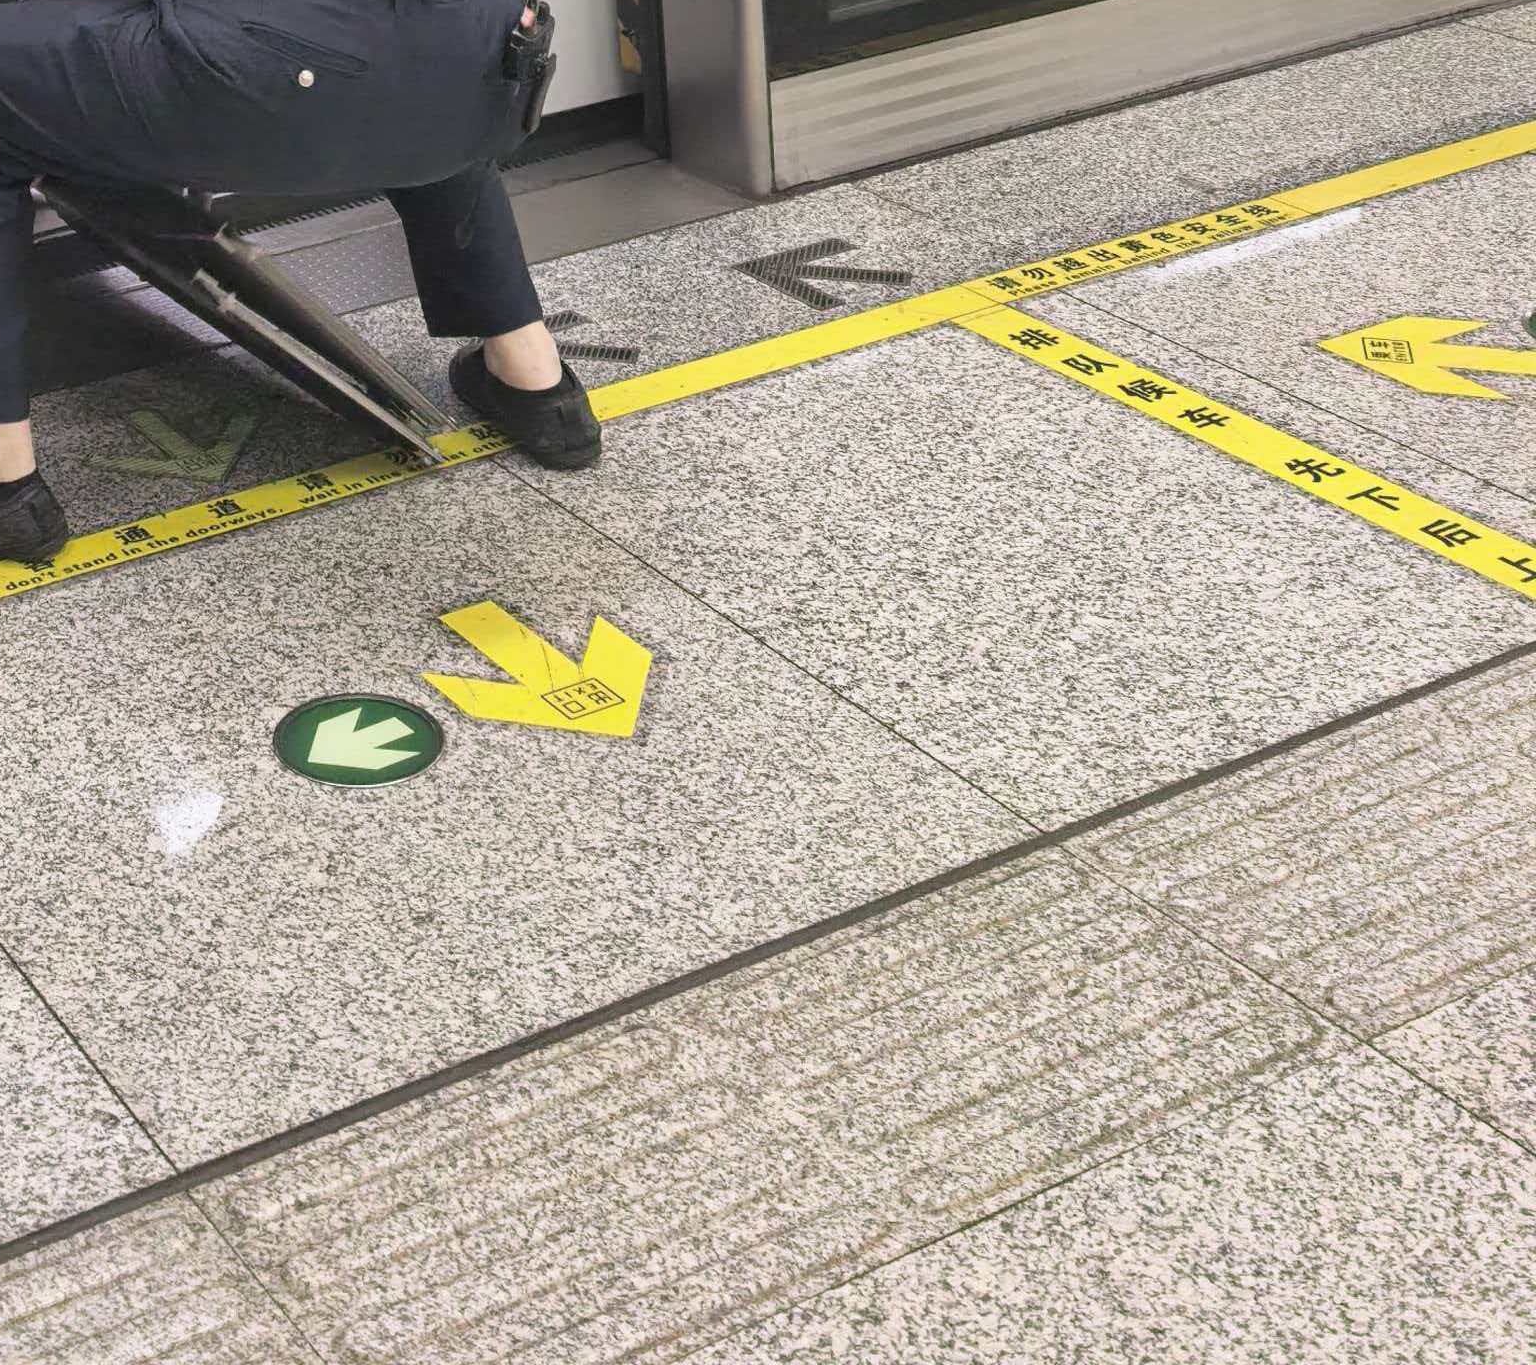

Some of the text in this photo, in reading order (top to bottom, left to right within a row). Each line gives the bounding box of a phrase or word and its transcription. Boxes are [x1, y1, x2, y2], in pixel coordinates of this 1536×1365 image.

[986, 202, 1279, 291] 请勿越出黄色安全线
[1120, 248, 1169, 267] behind
[1177, 238, 1199, 251] the
[1008, 328, 1536, 583] 排队候车 先下后上
[6, 570, 57, 592] don't
[63, 552, 118, 574] stand
[122, 545, 142, 557] in
[148, 535, 180, 550] the
[185, 506, 284, 541] doorways,
[298, 489, 340, 506] wait
[343, 479, 362, 491] in
[553, 683, 598, 702] EXIT
[562, 690, 613, 713] 出口
